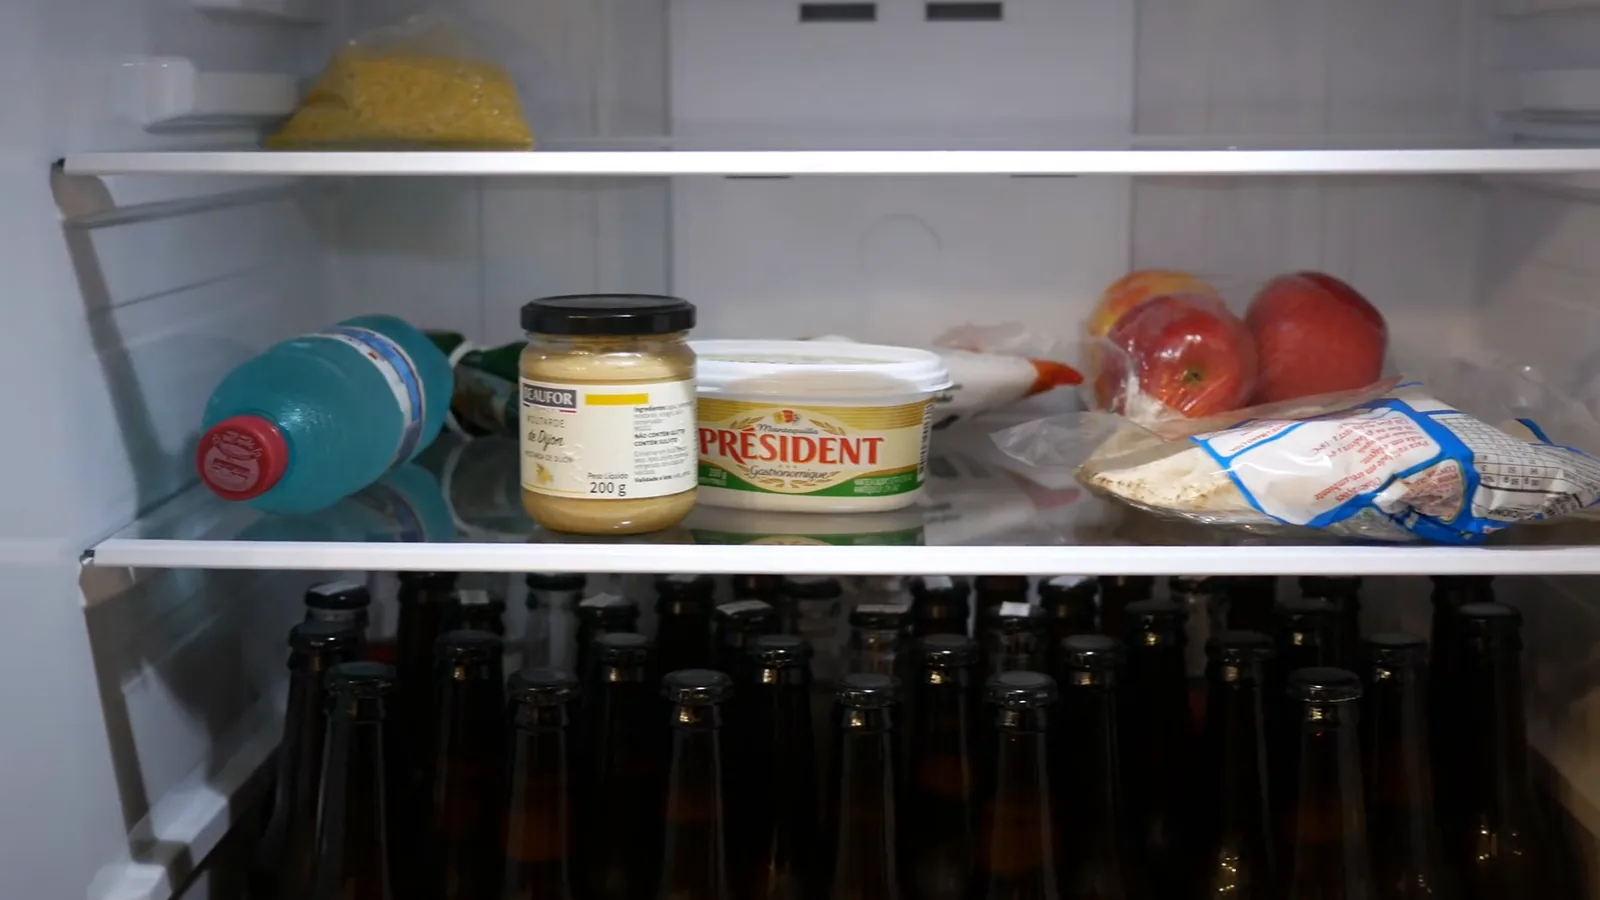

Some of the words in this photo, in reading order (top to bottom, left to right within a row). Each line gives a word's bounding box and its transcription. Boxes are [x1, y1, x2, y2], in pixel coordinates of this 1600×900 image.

[537, 429, 565, 452] Dijon
[698, 427, 885, 465] PRÉSIDENT
[588, 472, 603, 480] Peso
[604, 472, 629, 481] Líquido
[750, 465, 831, 480] Gastronomique
[590, 482, 614, 494] 200
[618, 483, 627, 497] g
